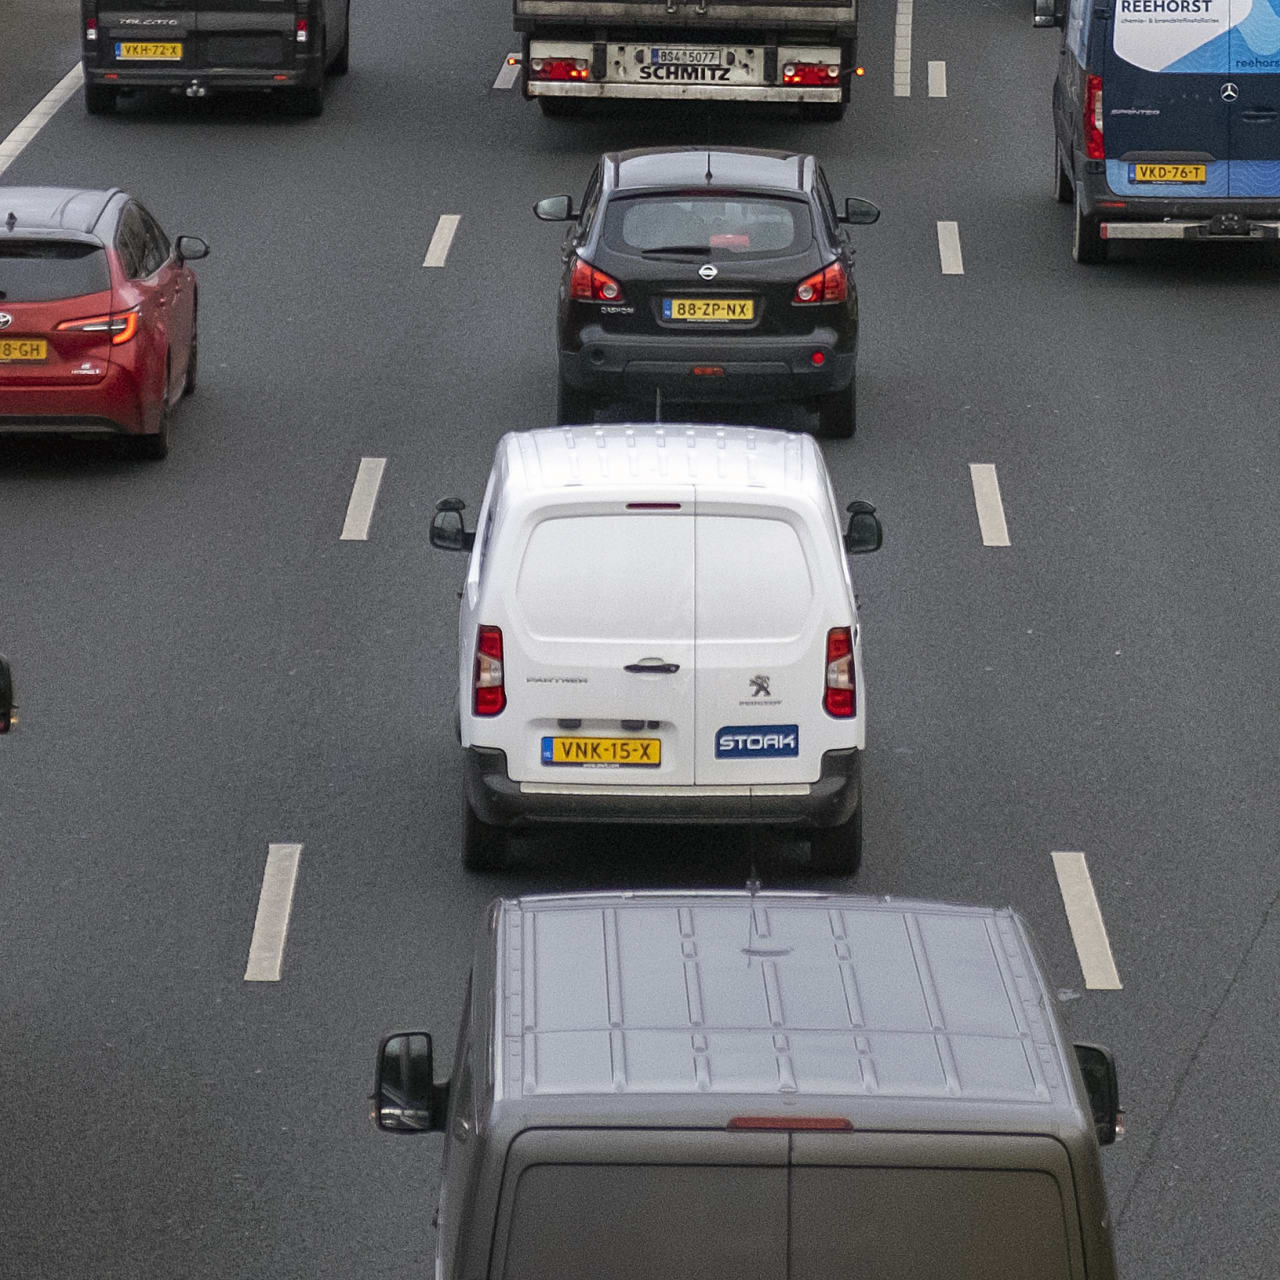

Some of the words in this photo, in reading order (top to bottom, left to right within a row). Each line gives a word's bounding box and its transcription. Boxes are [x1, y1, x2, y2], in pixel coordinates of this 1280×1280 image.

[1121, 0, 1213, 13] REEHORST
[123, 44, 178, 55] VKH-72-X
[660, 51, 681, 62] 8S4
[688, 52, 715, 63] 5077
[639, 65, 731, 81] SCHMITZ
[1140, 166, 1201, 179] VKD-76-T
[676, 303, 747, 316] 88-ZP-NX
[562, 742, 652, 760] VNK-15-X
